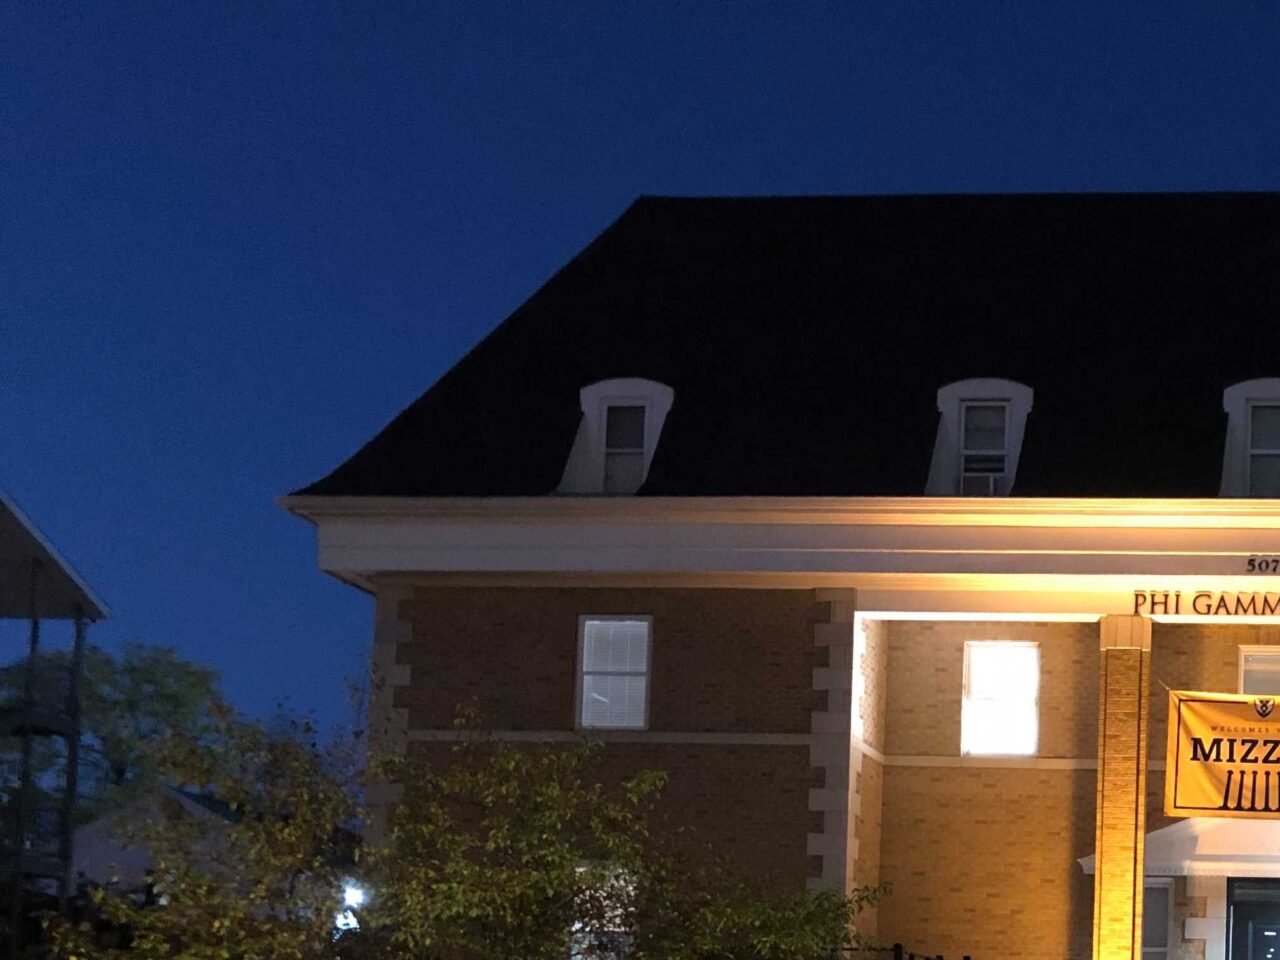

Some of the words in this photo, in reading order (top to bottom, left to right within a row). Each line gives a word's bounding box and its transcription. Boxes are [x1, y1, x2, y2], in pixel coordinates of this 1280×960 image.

[1246, 558, 1280, 573] 507
[1133, 593, 1181, 616] PHI
[1210, 725, 1270, 735] WELCOMES
